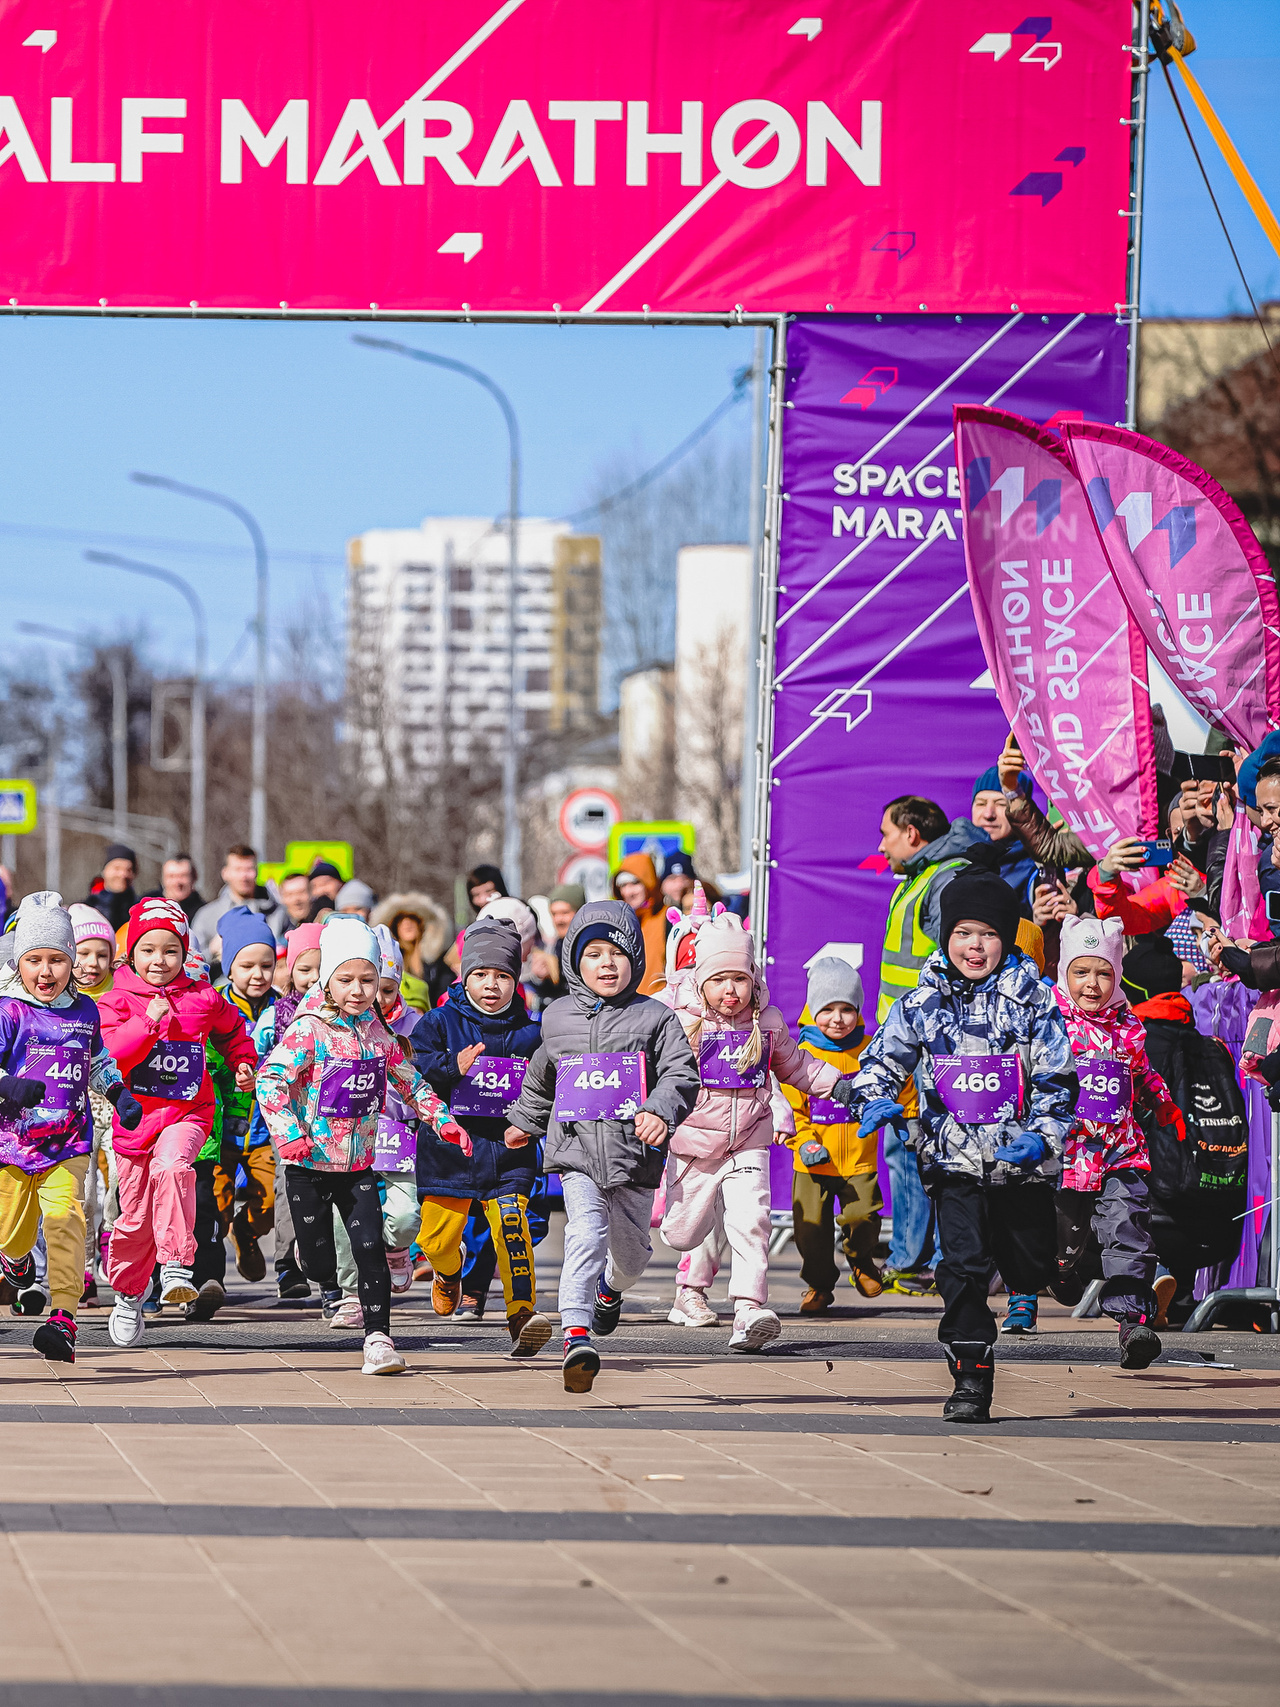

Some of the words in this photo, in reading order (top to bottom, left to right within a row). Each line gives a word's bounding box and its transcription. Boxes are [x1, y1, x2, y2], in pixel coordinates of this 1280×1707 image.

[74, 923, 111, 939] UNIQUE
[45, 1061, 83, 1081] 446
[148, 1055, 189, 1073] 402
[341, 1072, 376, 1091] 452
[471, 1072, 511, 1090] 434
[573, 1069, 622, 1090] 464
[952, 1072, 1001, 1092] 466
[1079, 1073, 1120, 1095] 436
